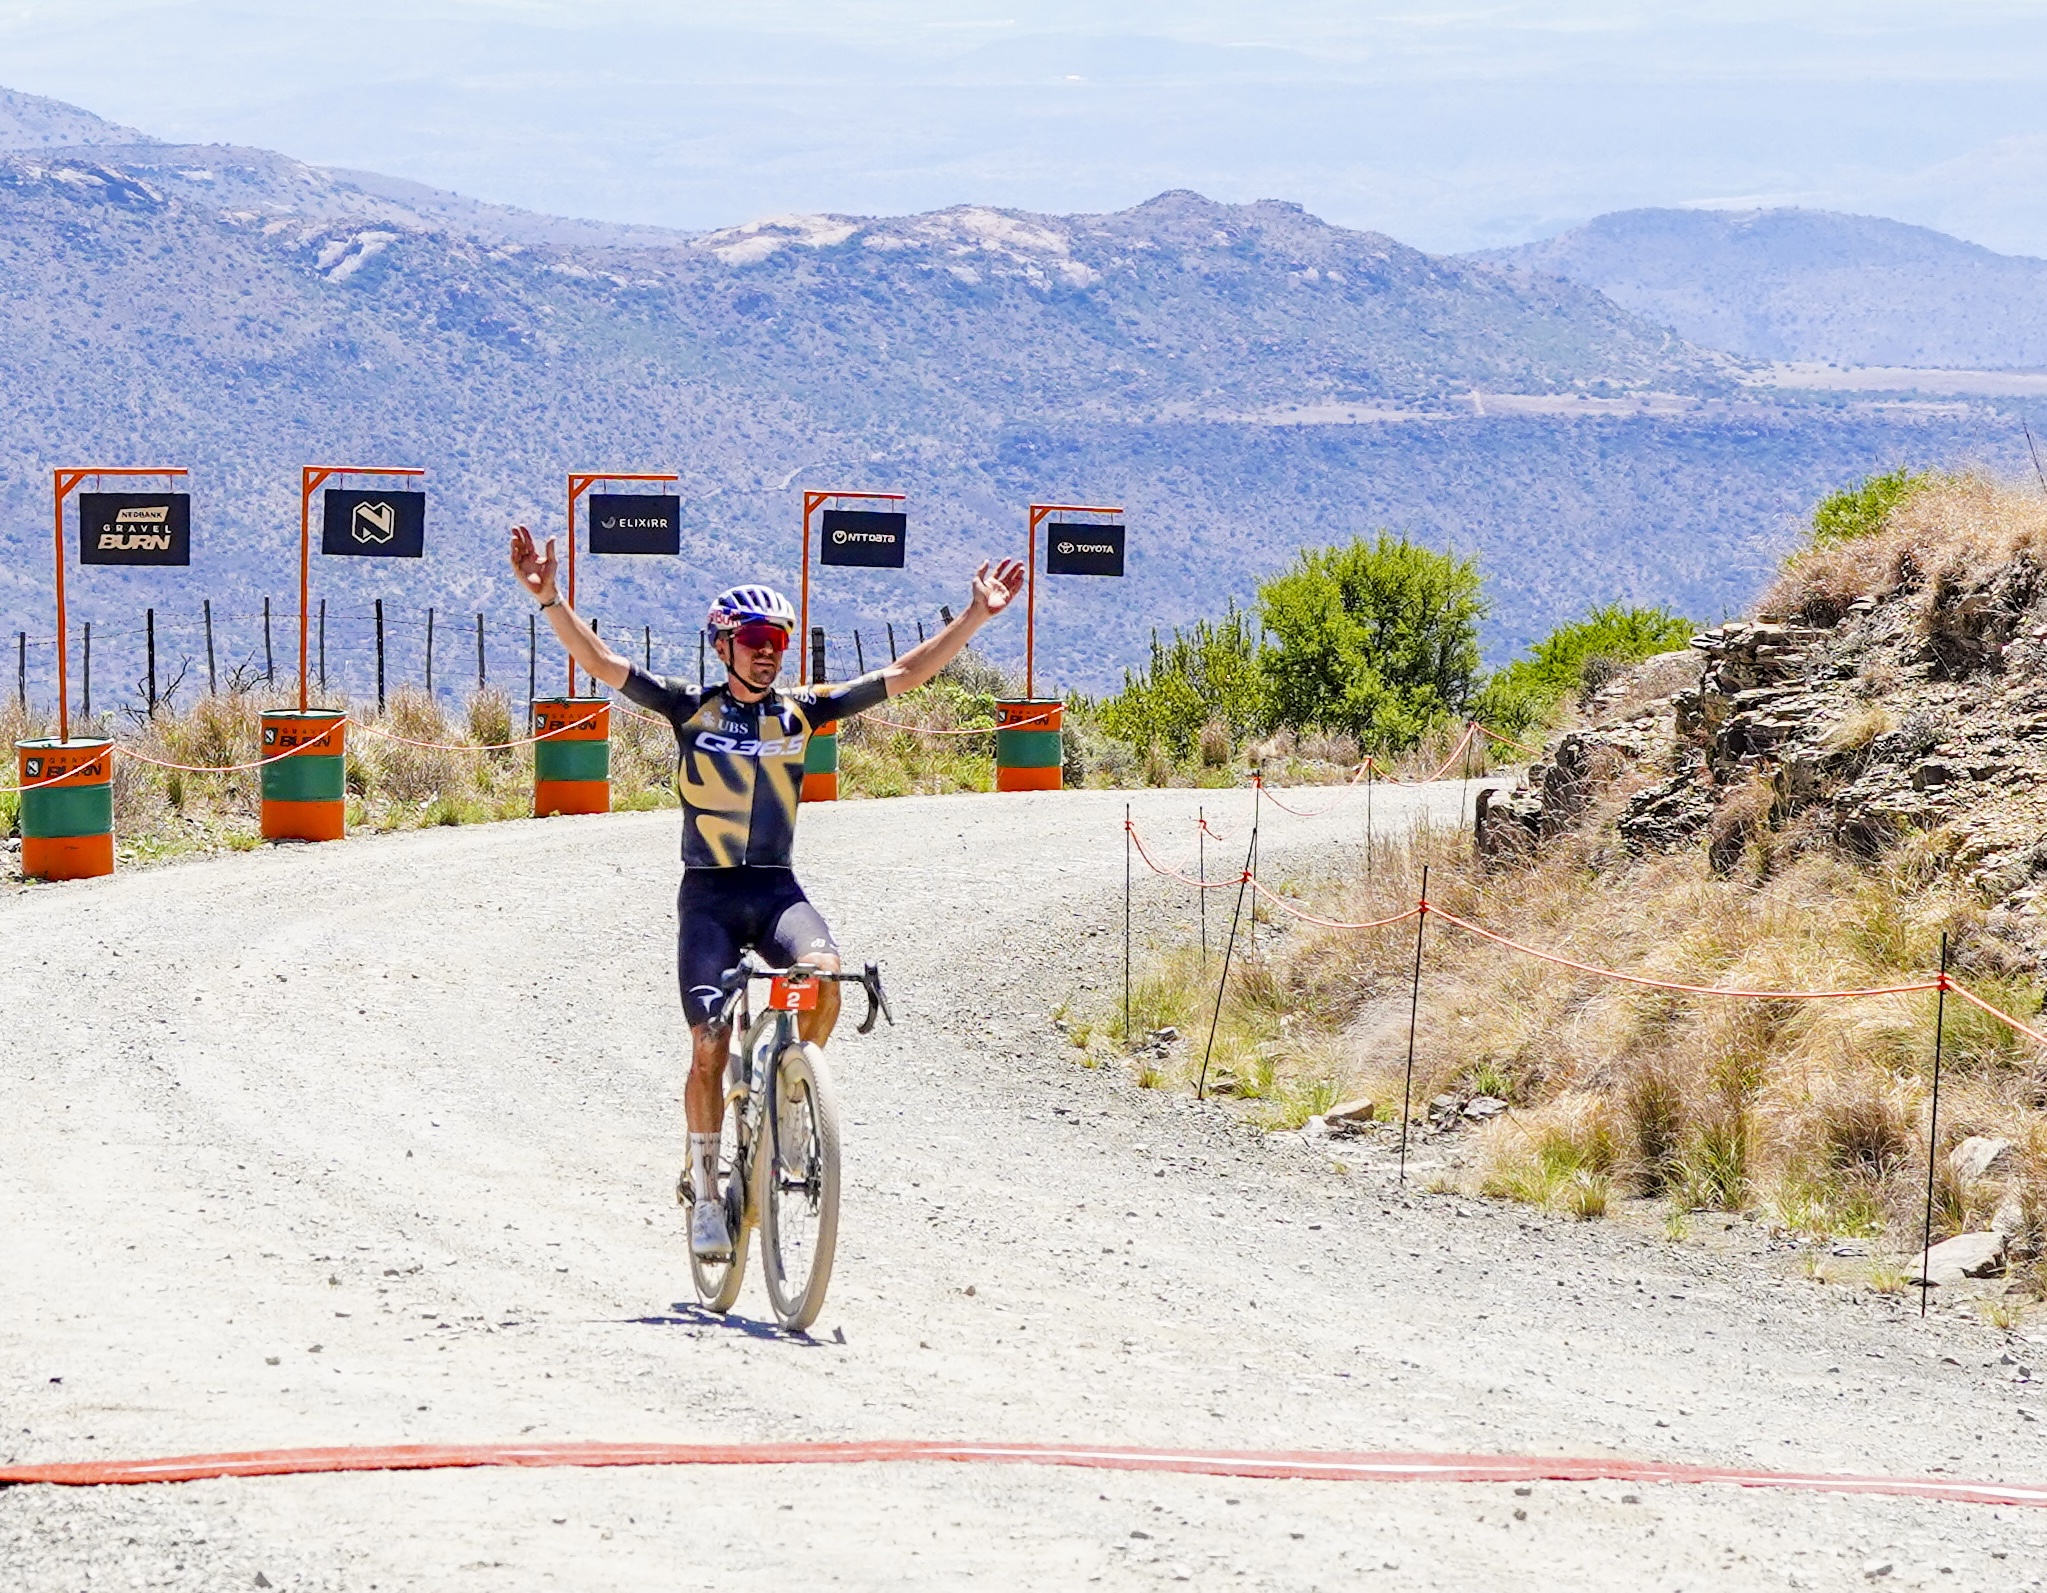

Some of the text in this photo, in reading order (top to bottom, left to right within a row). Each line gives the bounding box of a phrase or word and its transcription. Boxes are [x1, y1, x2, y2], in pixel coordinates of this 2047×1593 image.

[121, 511, 163, 519] NEDBANK
[102, 524, 172, 533] GRAVEL
[98, 534, 171, 550] BURN
[1076, 544, 1114, 554] TOYOTA
[718, 719, 749, 735] UBS
[786, 991, 801, 1008] 2
